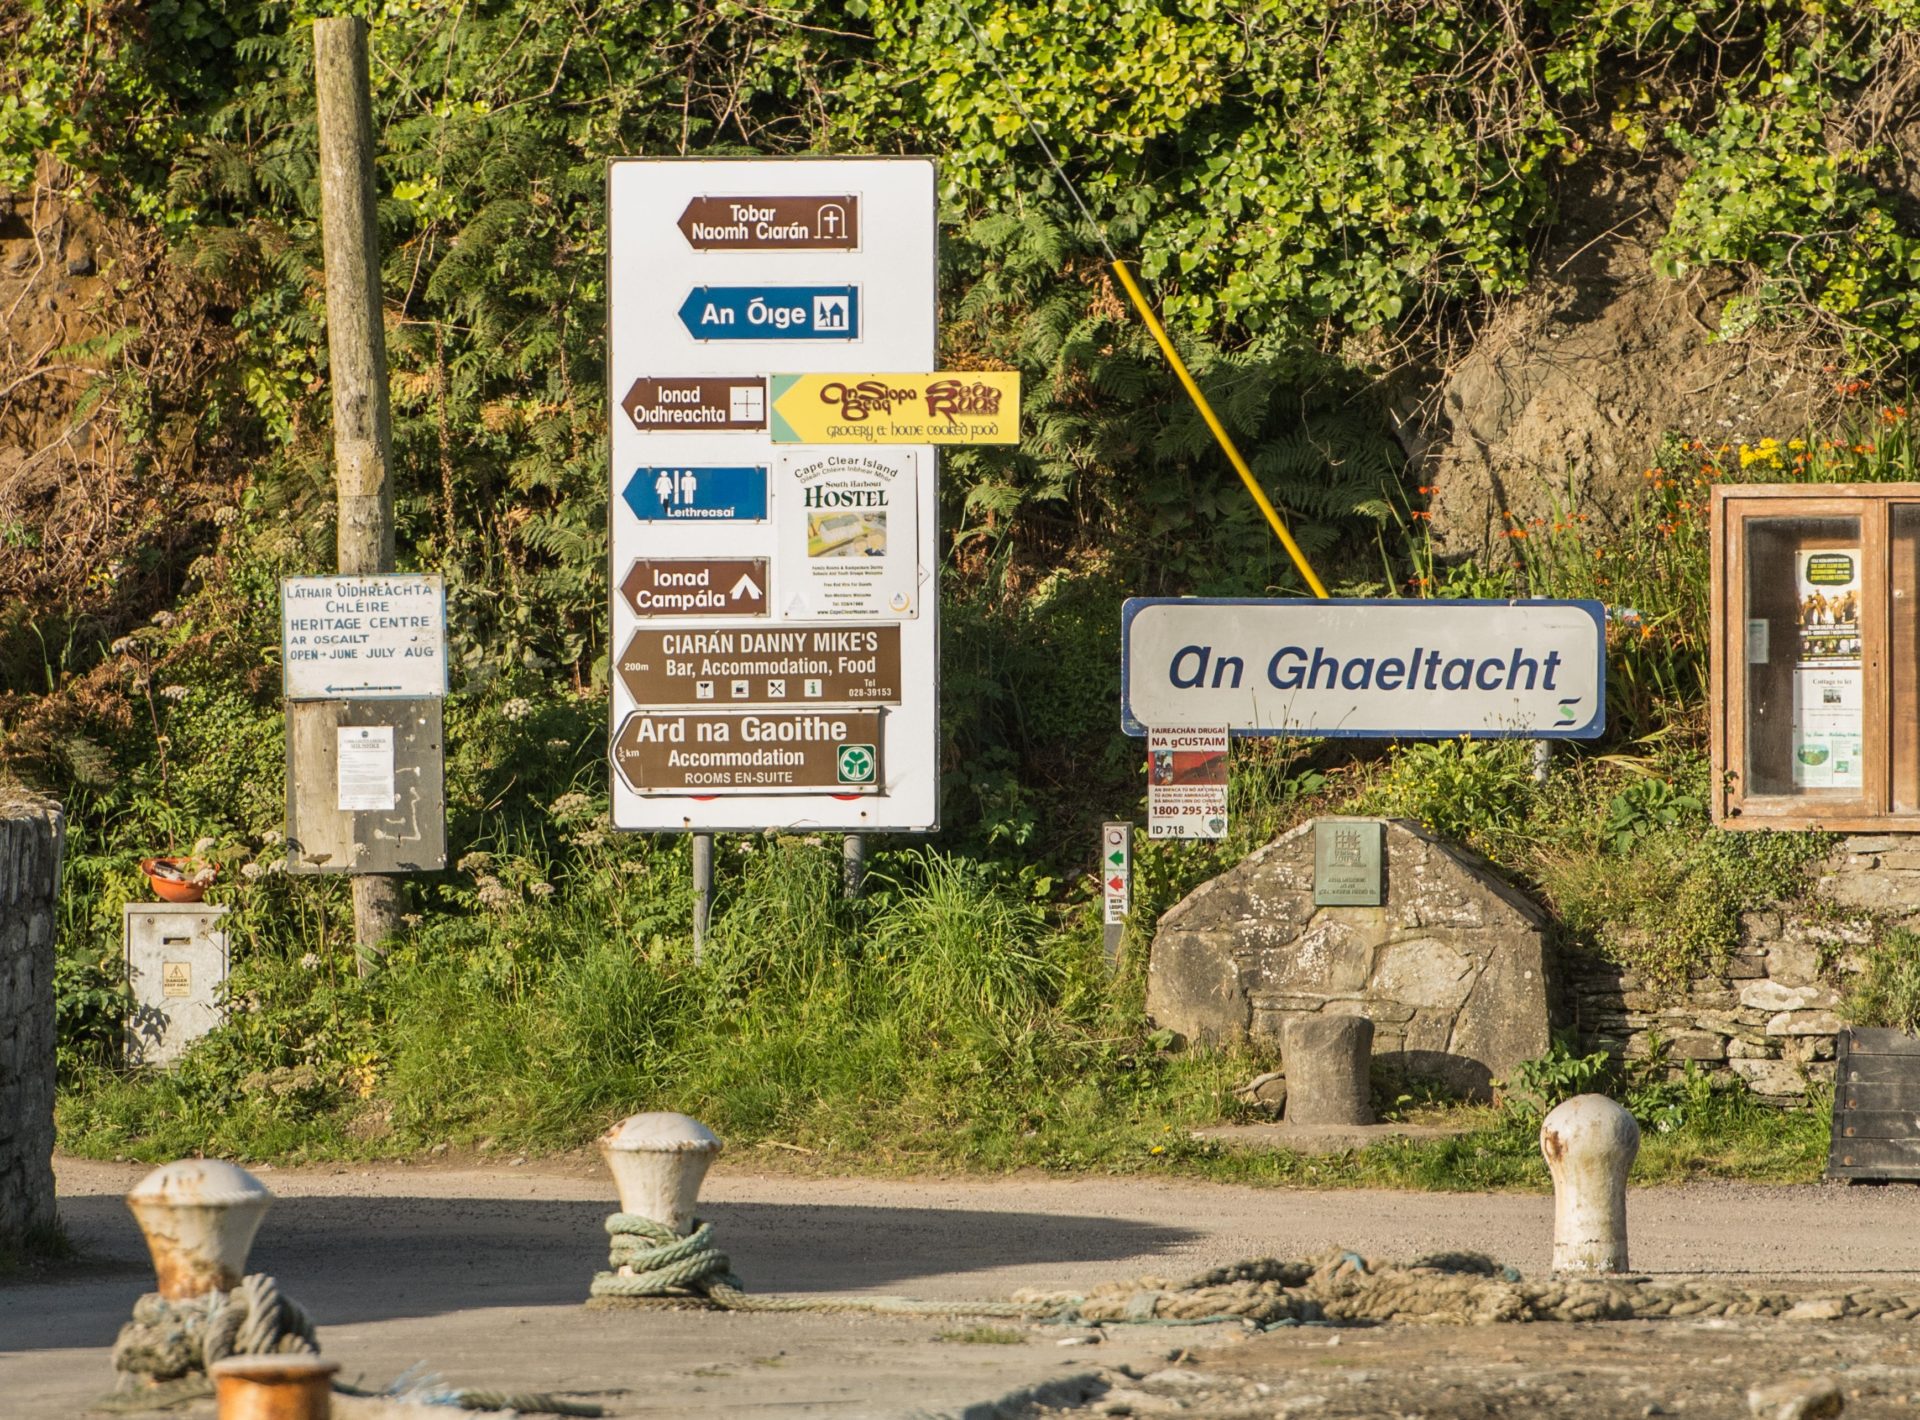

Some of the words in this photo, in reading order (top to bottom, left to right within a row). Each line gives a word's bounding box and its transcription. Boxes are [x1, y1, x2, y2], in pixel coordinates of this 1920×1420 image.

[730, 205, 776, 222] Tobar
[692, 223, 748, 240] Naomh
[701, 303, 734, 325] An
[658, 385, 700, 403] Ionad
[794, 461, 824, 478] Cape
[828, 456, 859, 466] Clear
[863, 457, 898, 478] Island
[804, 485, 889, 508] HOSTEL
[654, 569, 709, 587] Ionad
[287, 584, 332, 599] LÁTHAIR
[636, 589, 725, 611] Campála
[326, 600, 390, 613] CHLÉIRE
[291, 618, 361, 631] HERITAGE
[370, 616, 430, 629] CENTRE
[291, 636, 306, 645] AR
[314, 634, 369, 644] OSCAILT
[662, 630, 734, 655] CIARÁN
[740, 633, 808, 653] DANNY
[813, 631, 878, 652] MIKE'S
[290, 650, 318, 660] OPEN
[330, 649, 358, 660] JUNE
[366, 648, 396, 659] JULY
[404, 647, 434, 657] AUG
[624, 662, 649, 672] 200m
[666, 660, 696, 679] Bar,
[701, 658, 833, 678] Accommodation,
[838, 656, 876, 674] Food
[1266, 645, 1562, 691] Ghaeltacht
[863, 679, 876, 687] Tel
[637, 718, 685, 743] Ard
[696, 722, 729, 743] na
[741, 717, 847, 742] Gaoithe
[1152, 738, 1167, 746] NA
[1171, 737, 1225, 748] gCUSTAIM
[668, 749, 804, 768] Accommodation
[685, 772, 731, 784] ROOMS
[735, 772, 793, 784] EN-SUITE
[1152, 806, 1179, 815] 1800
[1182, 806, 1202, 815] 295
[1205, 805, 1225, 815] 295
[1152, 825, 1163, 834] ID
[1166, 825, 1184, 835] 718
